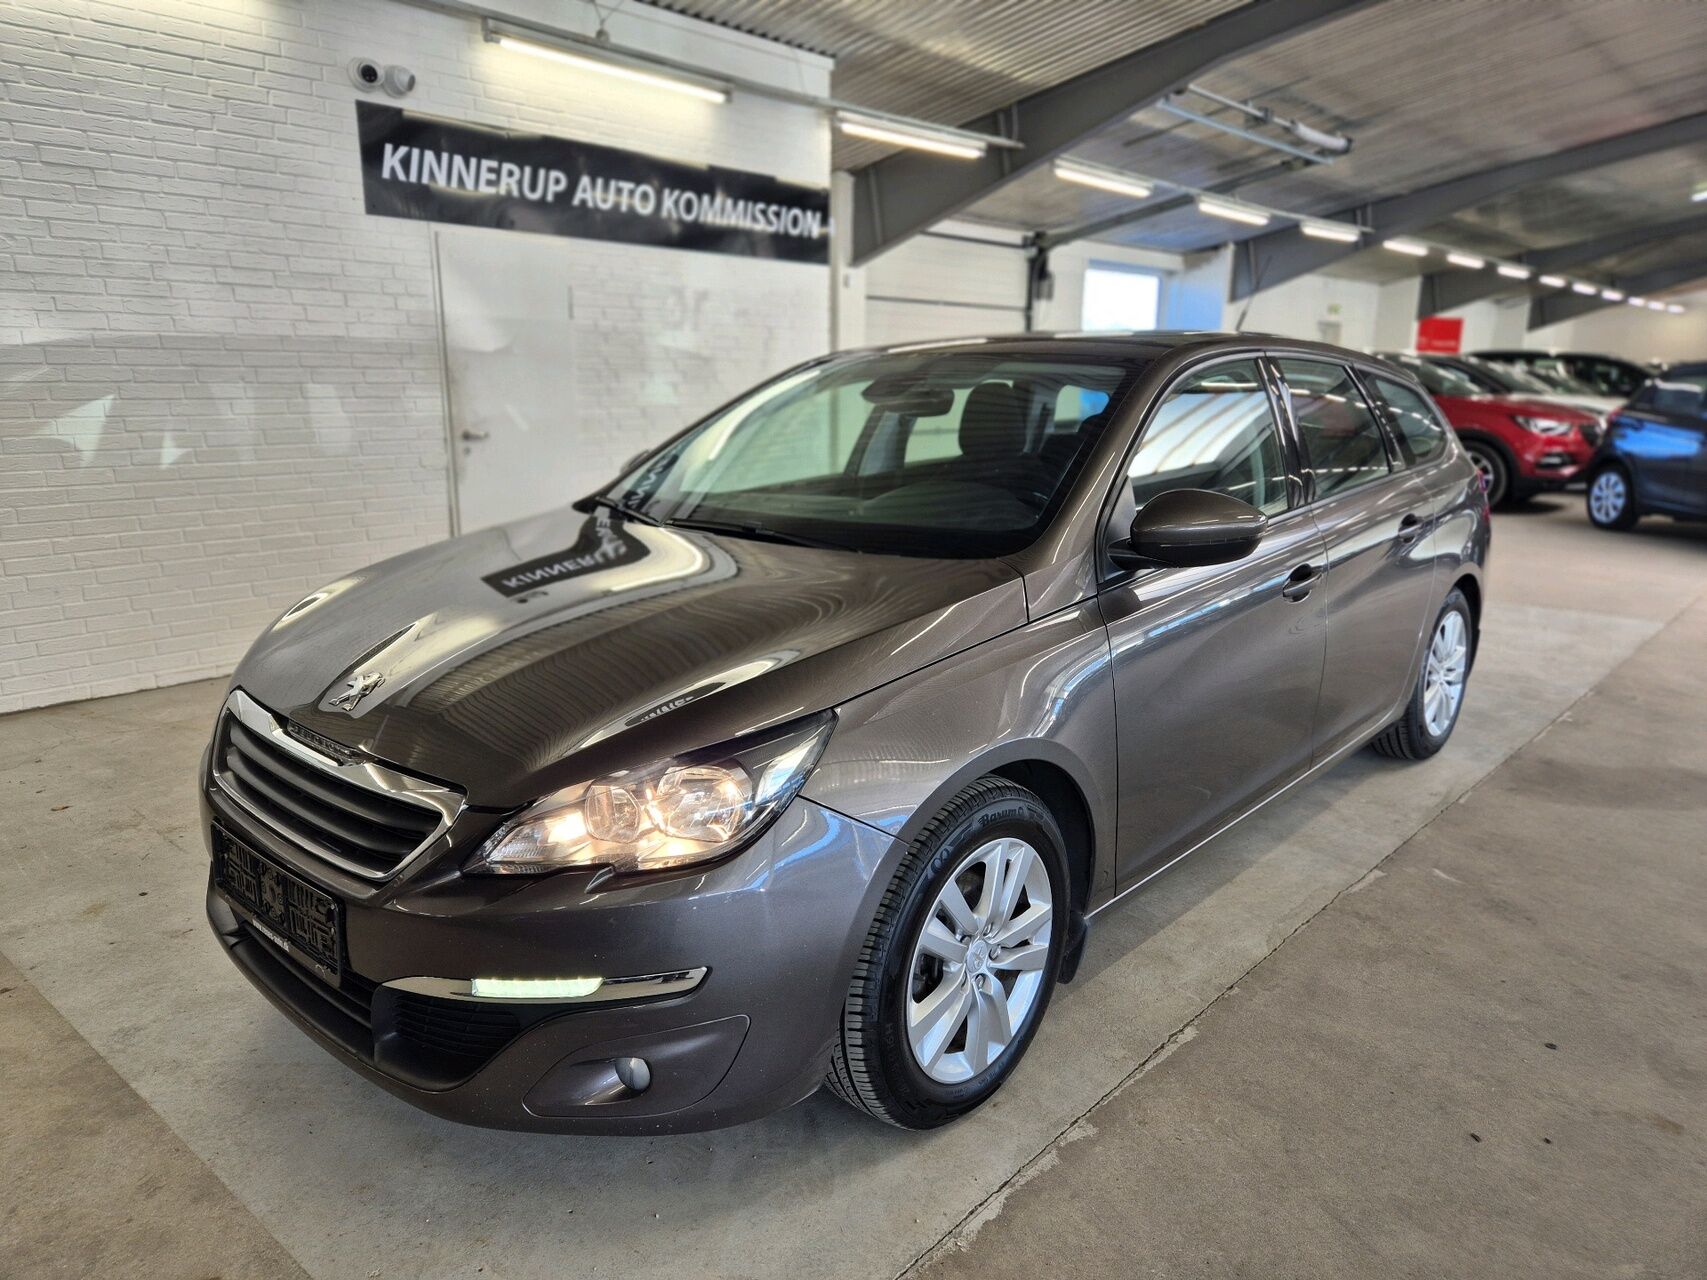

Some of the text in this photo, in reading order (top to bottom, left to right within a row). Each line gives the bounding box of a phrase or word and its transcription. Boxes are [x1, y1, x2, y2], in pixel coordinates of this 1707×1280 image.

[381, 143, 568, 203] KINNERUP
[572, 175, 656, 216] AUTO
[660, 188, 822, 239] KOMMISSION
